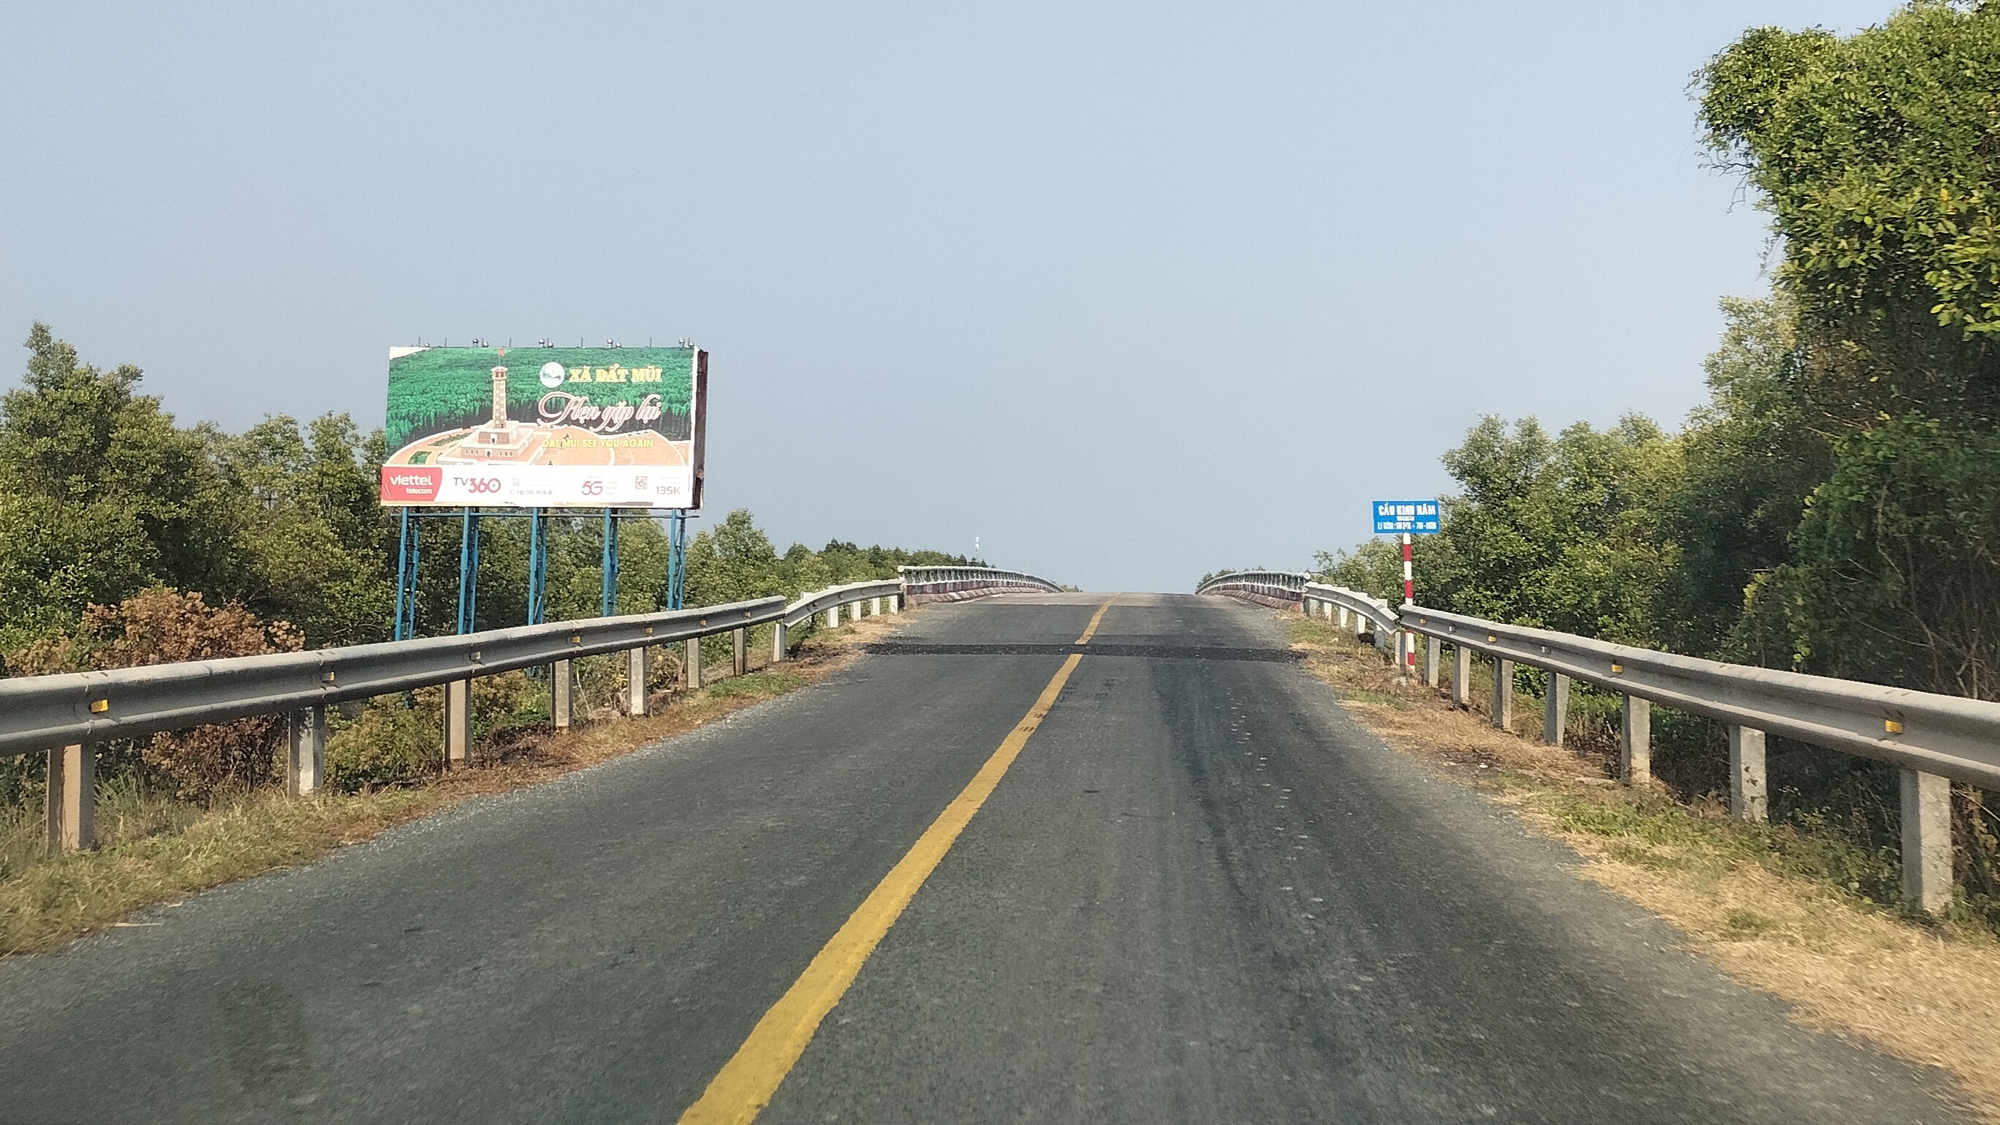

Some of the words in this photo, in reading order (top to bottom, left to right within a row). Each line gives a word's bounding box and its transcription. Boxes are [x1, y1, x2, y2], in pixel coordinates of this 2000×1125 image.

[536, 391, 602, 426] Hẹn
[589, 401, 635, 432] gặp
[635, 394, 662, 424] lại
[582, 439, 598, 448] SEE
[601, 438, 620, 448] YOU
[622, 438, 654, 448] AGAIN
[389, 474, 433, 486] viettel
[406, 487, 433, 495] telecom
[581, 481, 603, 496] 5G
